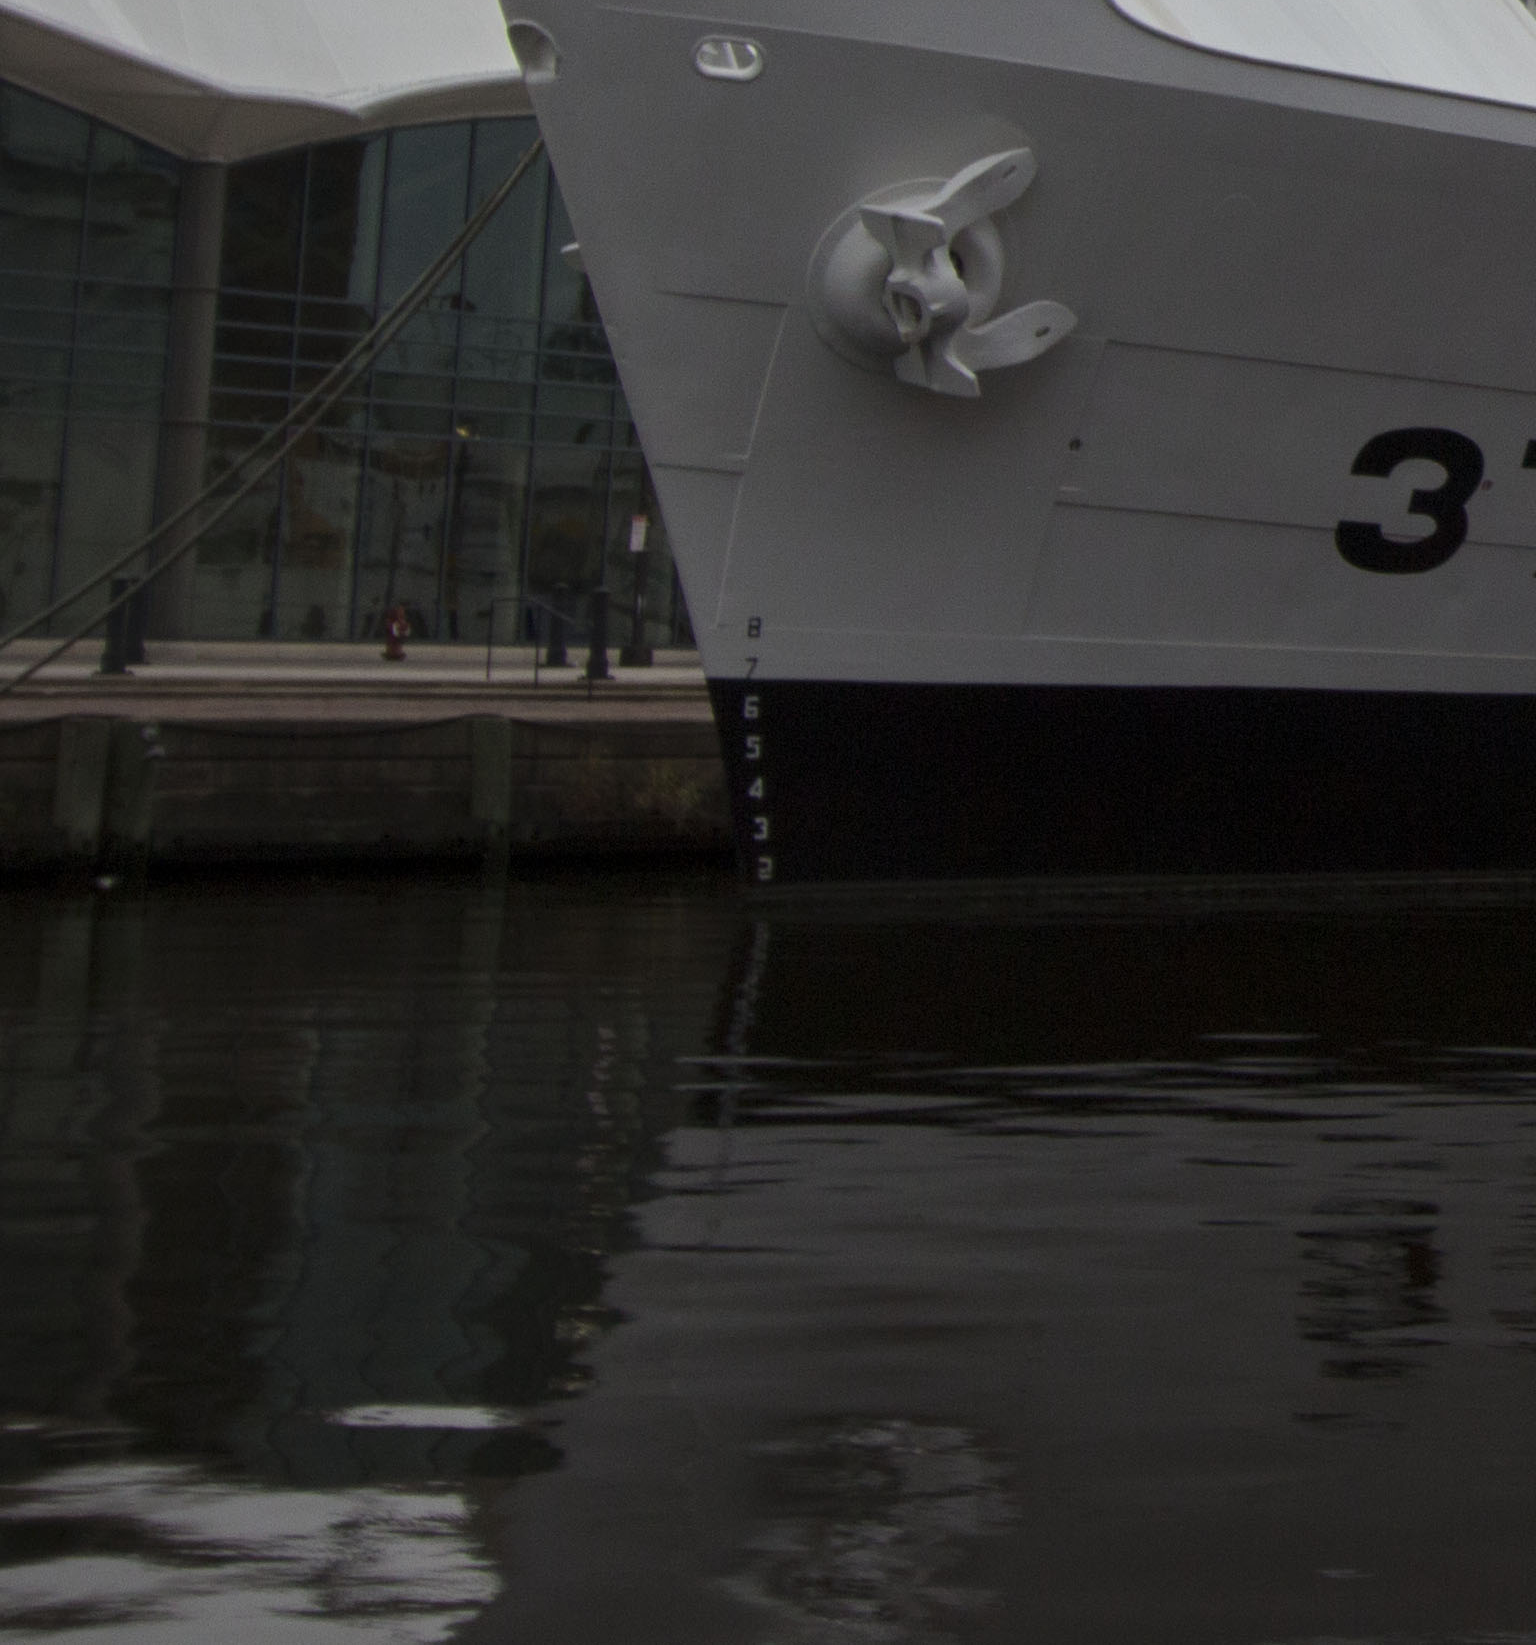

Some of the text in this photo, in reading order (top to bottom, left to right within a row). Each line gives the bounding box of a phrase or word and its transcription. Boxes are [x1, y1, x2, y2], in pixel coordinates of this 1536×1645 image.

[747, 617, 762, 638] 8
[746, 658, 758, 679] 7
[744, 696, 759, 719] 6
[747, 737, 760, 759] 5
[749, 778, 763, 799] 4
[754, 817, 768, 841] 3
[758, 856, 773, 880] 2
